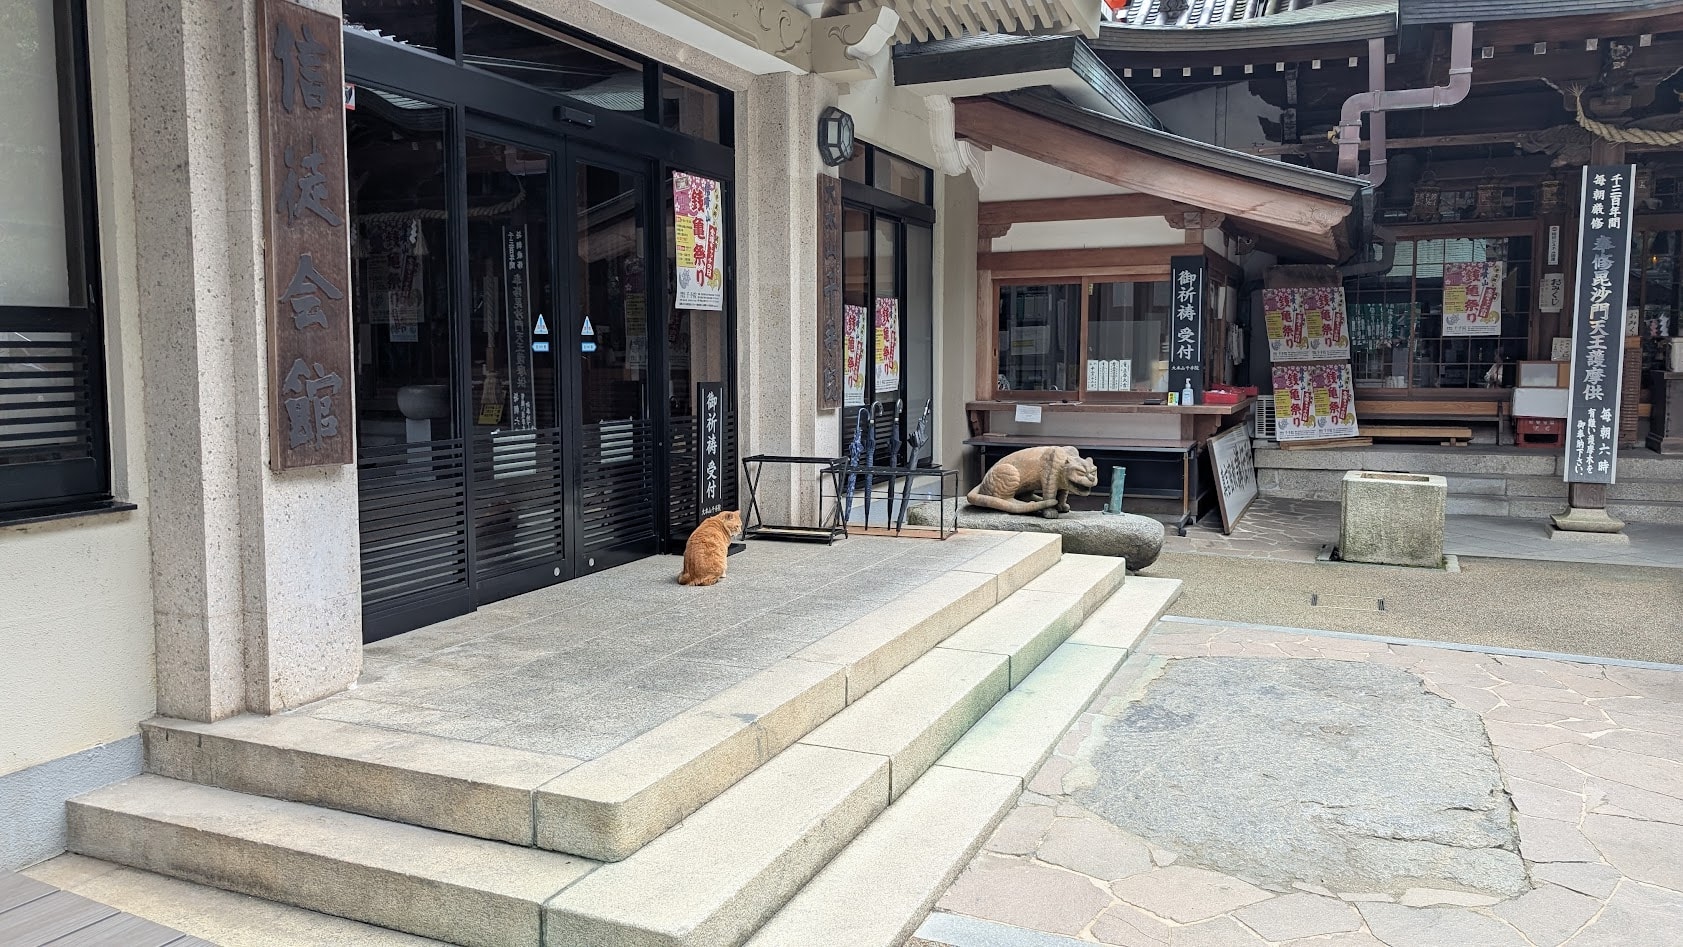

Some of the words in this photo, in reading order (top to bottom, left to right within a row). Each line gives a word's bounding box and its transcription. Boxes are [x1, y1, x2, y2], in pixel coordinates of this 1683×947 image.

[1590, 173, 1606, 230] 毎朝厳修
[273, 22, 344, 452] 信徒会館
[1598, 407, 1612, 475] 毎朝六時
